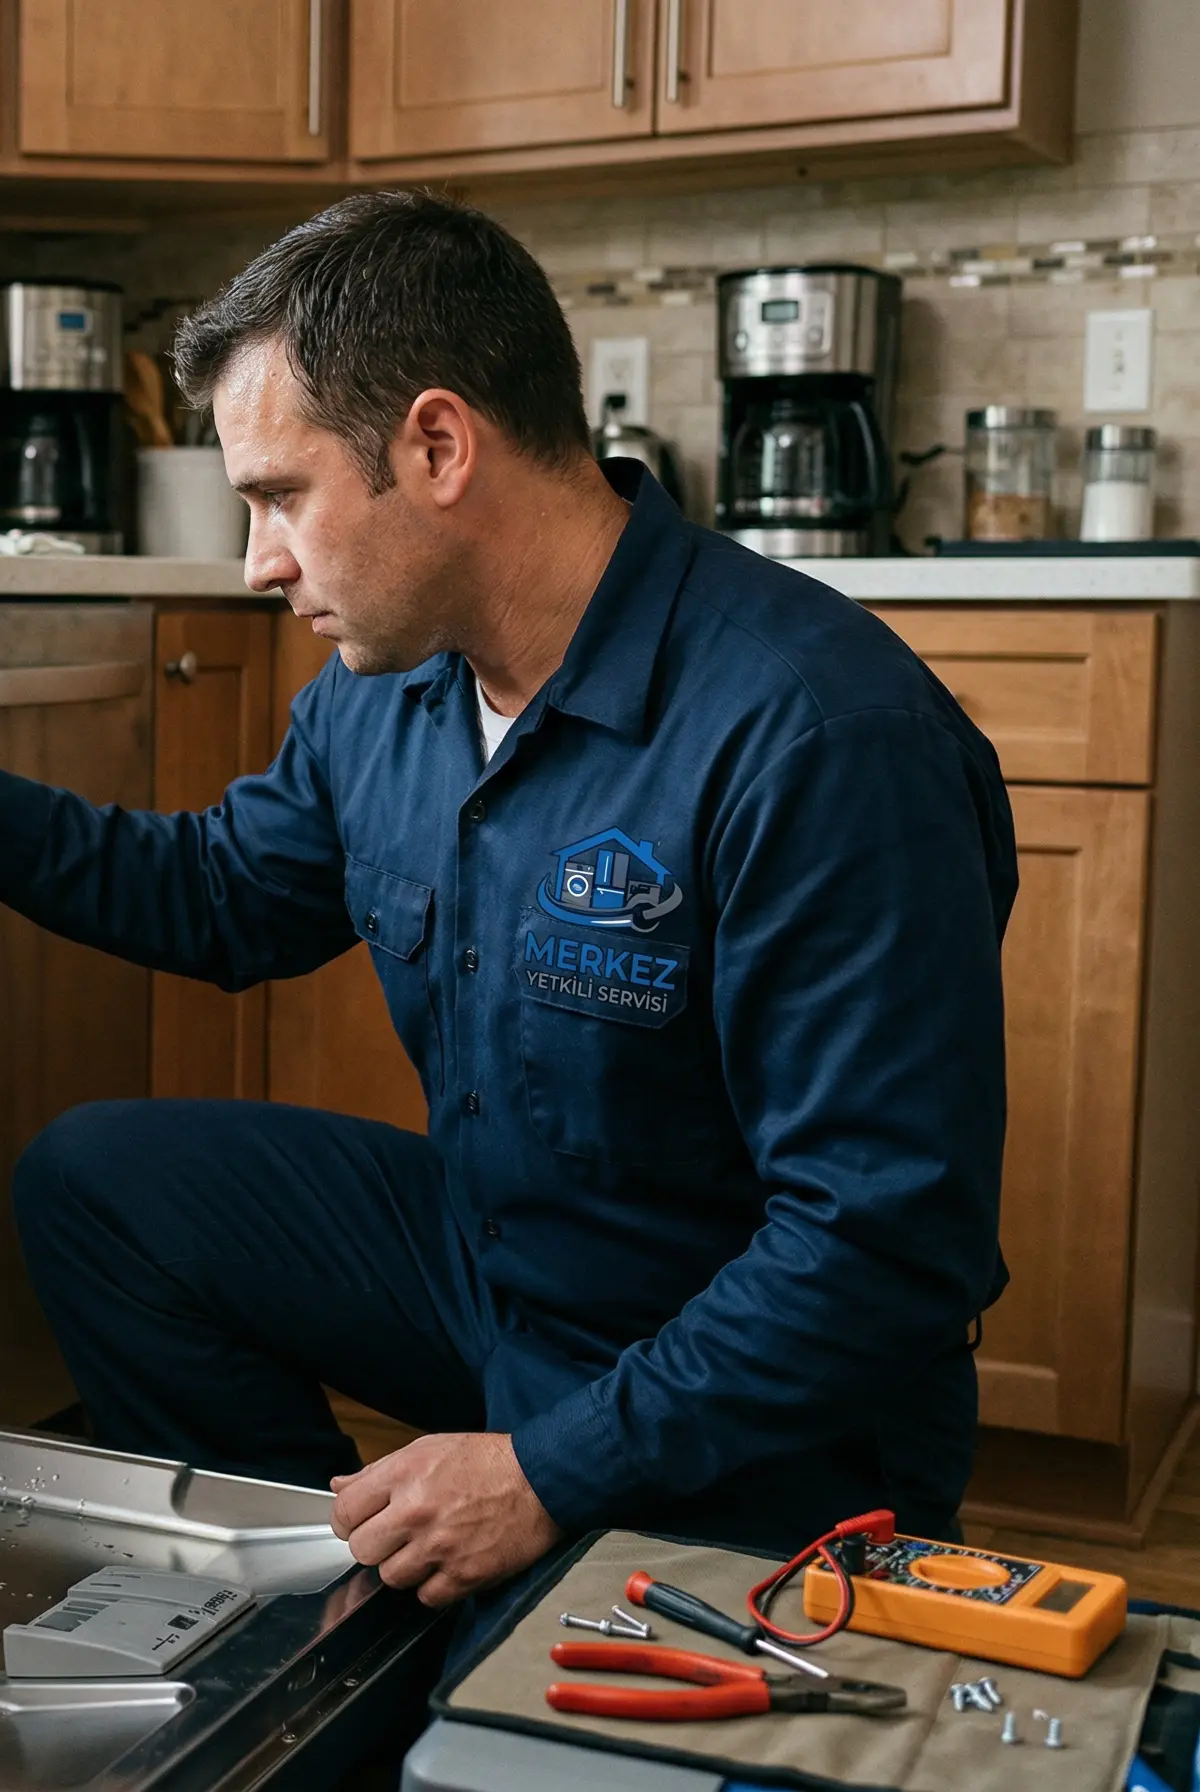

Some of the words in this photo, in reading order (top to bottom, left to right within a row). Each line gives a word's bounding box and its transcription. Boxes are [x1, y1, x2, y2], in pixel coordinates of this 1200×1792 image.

[524, 932, 679, 990] MERKEZ
[526, 971, 593, 998] YETKİLİ
[597, 986, 668, 1013] SERVİSİ
